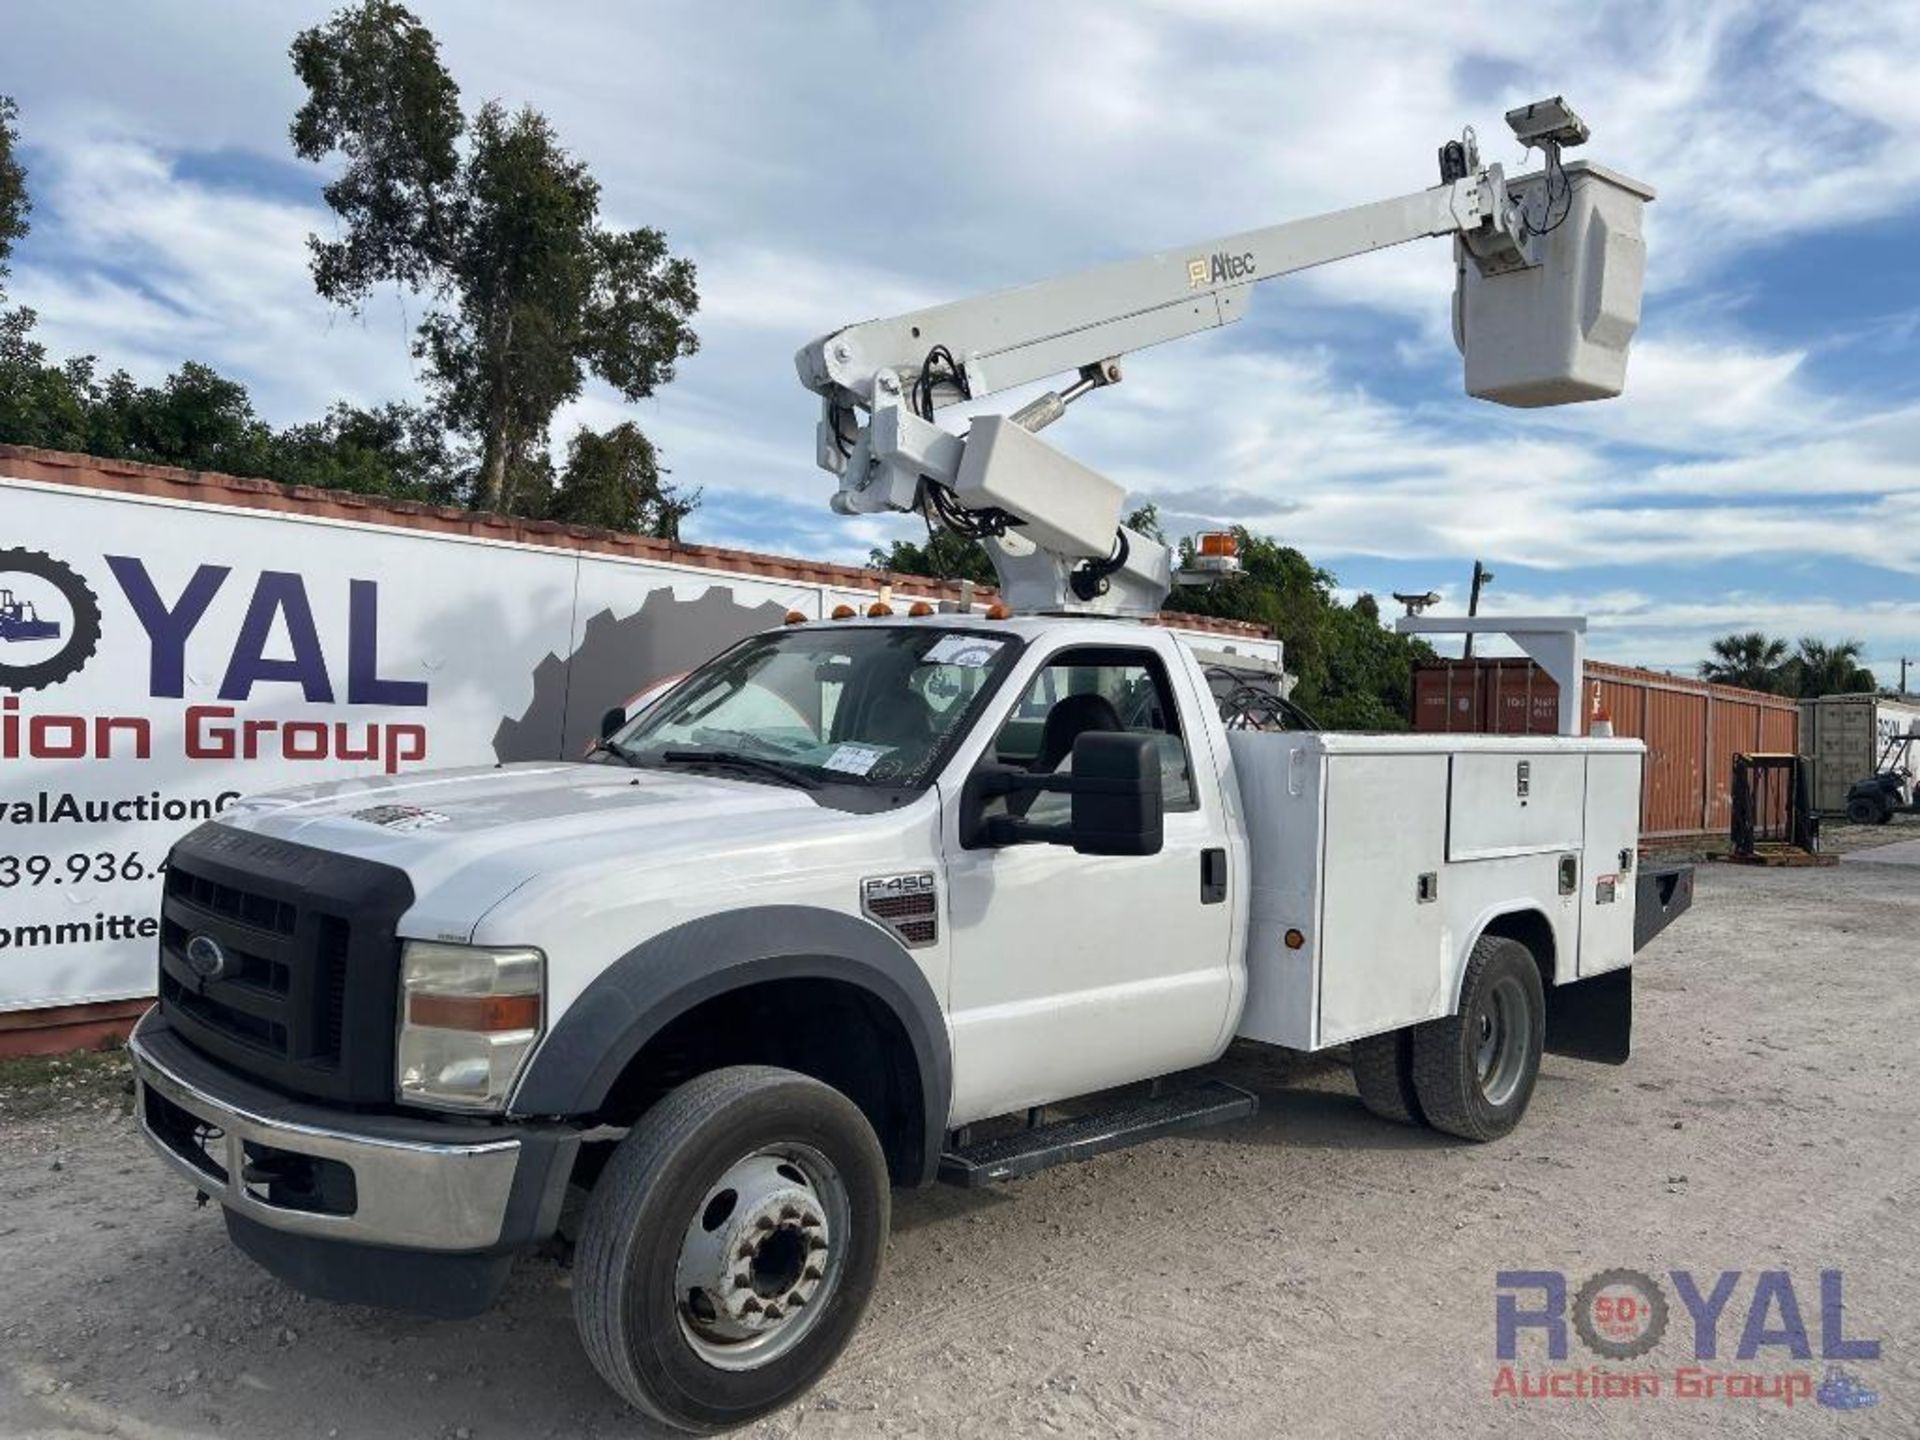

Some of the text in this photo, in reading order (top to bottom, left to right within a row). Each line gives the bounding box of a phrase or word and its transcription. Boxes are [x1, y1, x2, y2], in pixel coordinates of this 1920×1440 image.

[1211, 252, 1256, 282] Altec
[185, 705, 427, 774] Group
[866, 875, 934, 894] F-450
